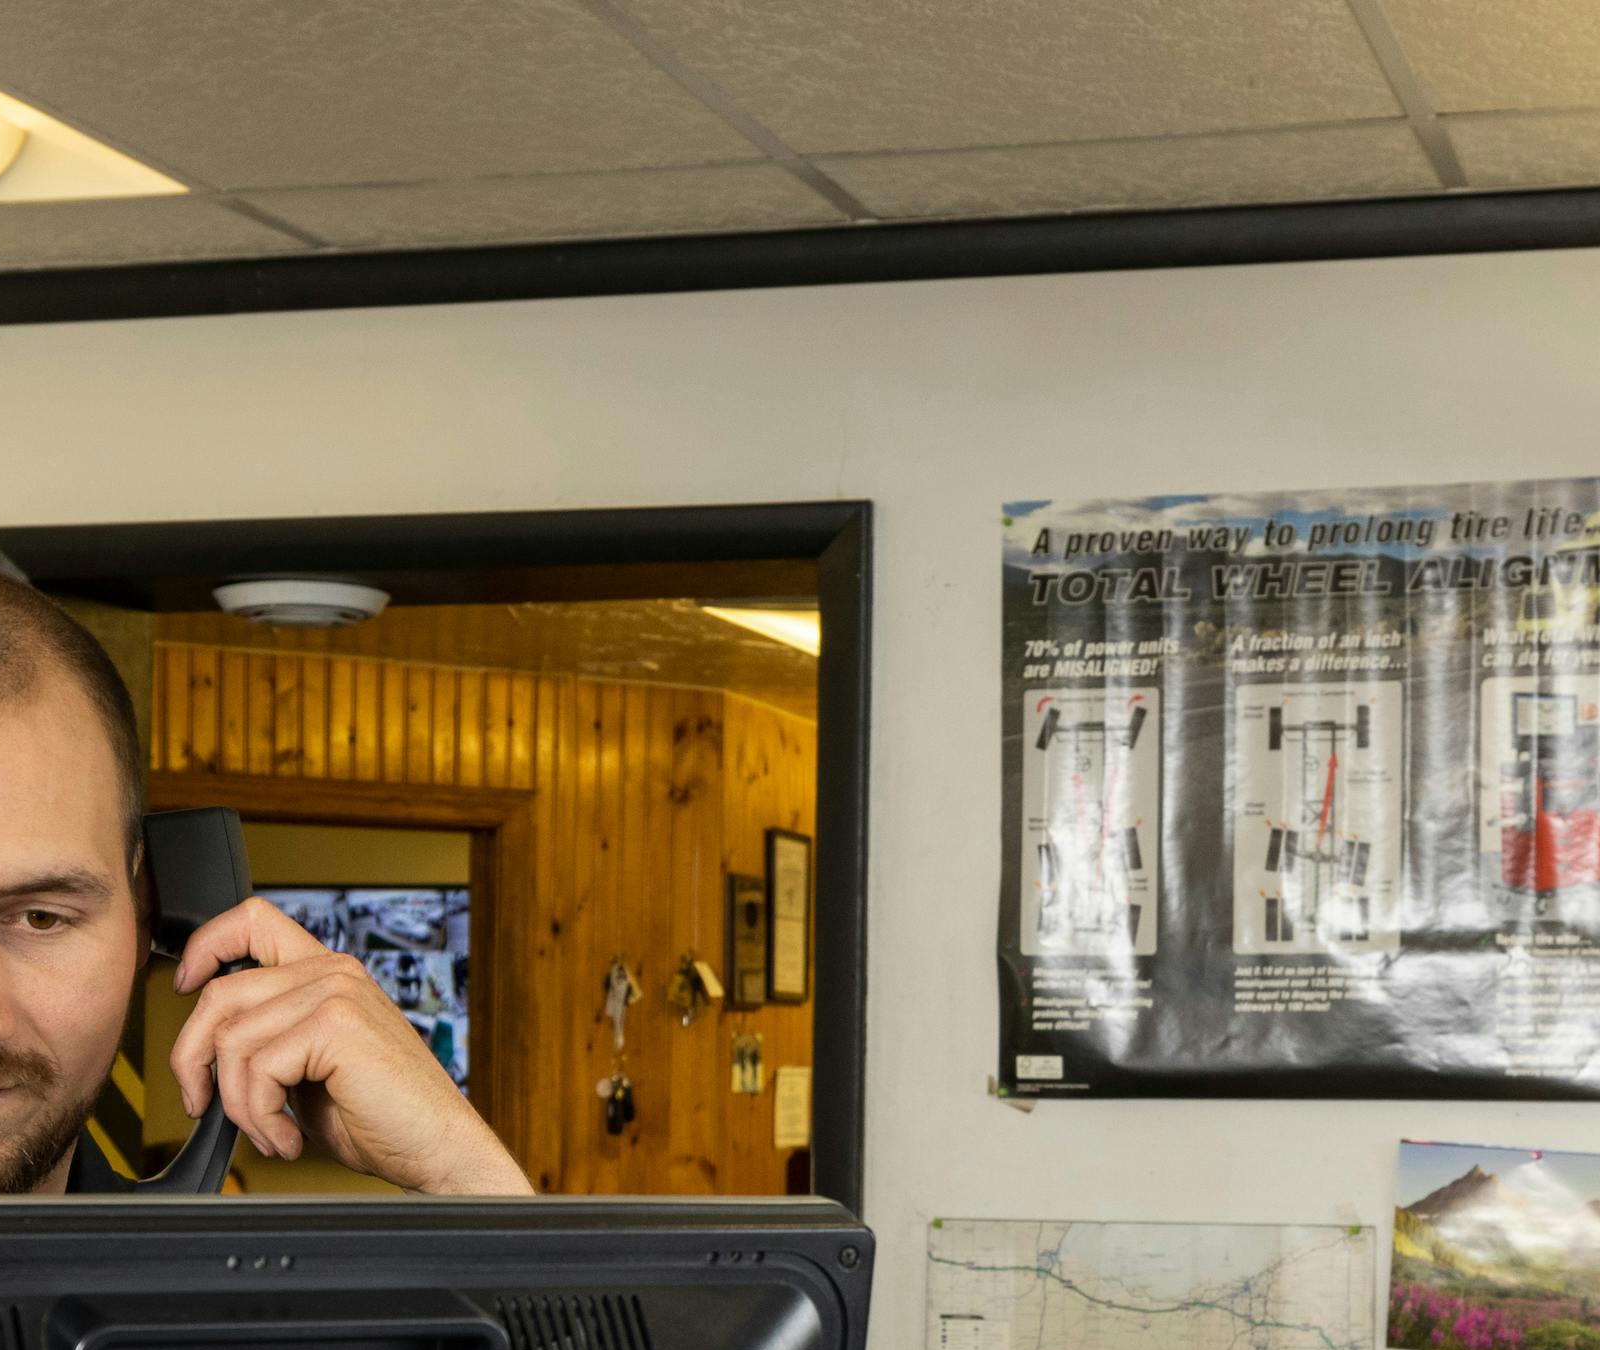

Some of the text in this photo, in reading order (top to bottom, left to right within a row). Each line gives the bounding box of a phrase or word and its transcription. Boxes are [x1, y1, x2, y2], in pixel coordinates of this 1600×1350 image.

[1032, 527, 1051, 555] A
[1063, 526, 1173, 560] proven
[1187, 524, 1251, 552] way
[1263, 518, 1296, 547] to
[1307, 514, 1435, 552] prolong
[1450, 510, 1510, 541] tire
[1028, 566, 1193, 607] TOTAL
[1210, 558, 1394, 600] WHEEL
[1024, 639, 1060, 659] 70%
[1063, 638, 1082, 657] of
[1083, 640, 1136, 660] power
[1230, 634, 1247, 654] A
[1248, 632, 1315, 654] fraction
[1316, 631, 1336, 651] of
[1337, 635, 1362, 651] an
[1023, 658, 1160, 680] are MISALIGNED!
[1230, 653, 1285, 675] makes
